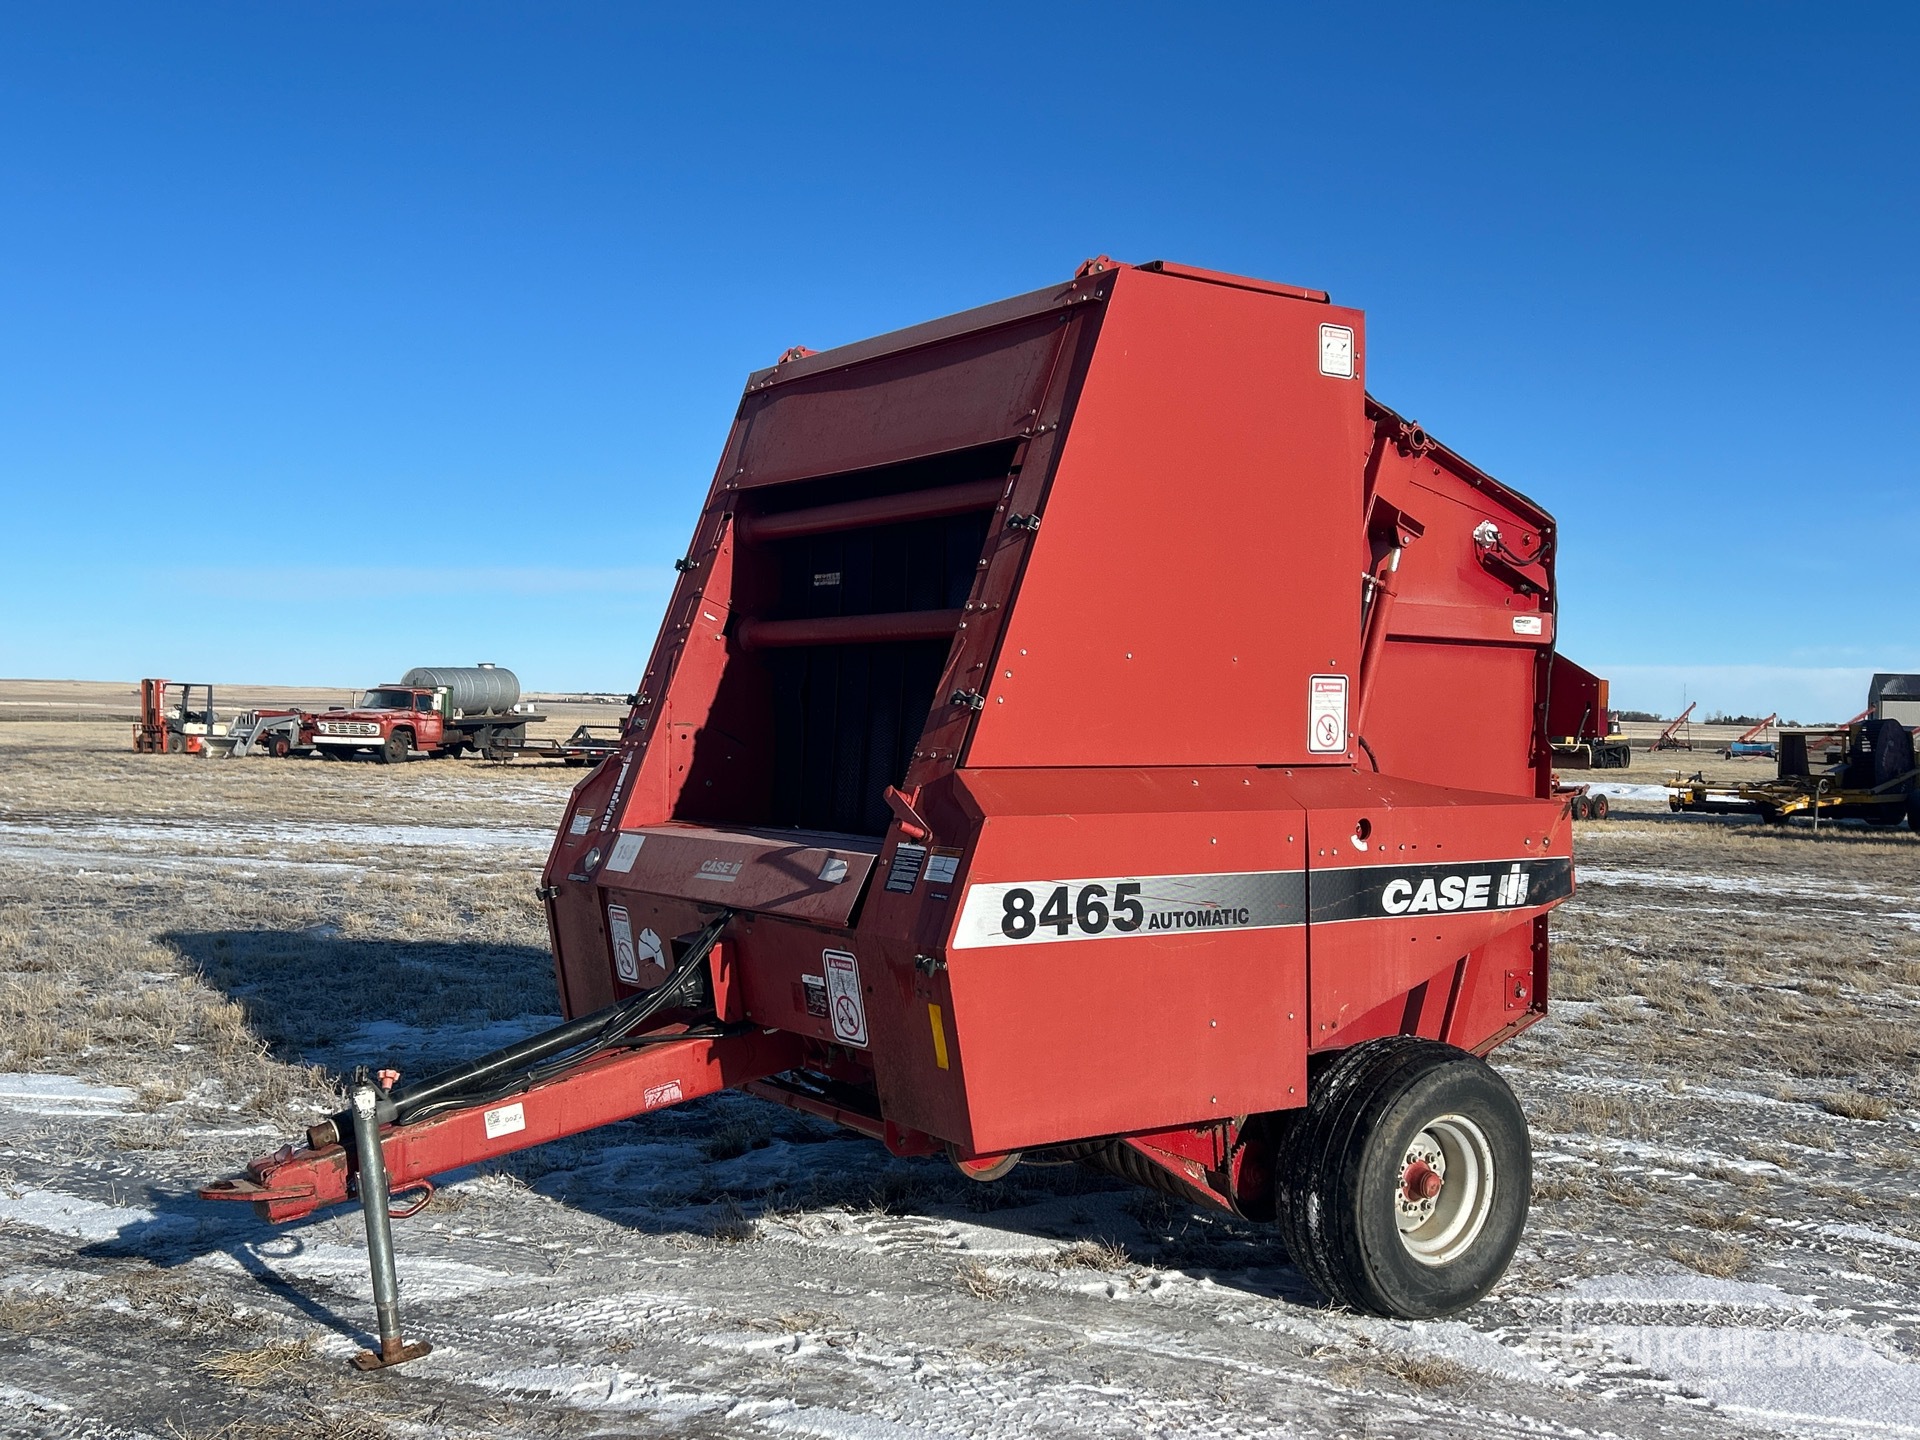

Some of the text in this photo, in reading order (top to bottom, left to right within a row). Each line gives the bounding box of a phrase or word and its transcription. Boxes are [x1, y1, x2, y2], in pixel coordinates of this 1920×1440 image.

[701, 859, 731, 874] CASE
[1001, 882, 1250, 940] 8465 AUTOMATIC
[1381, 874, 1491, 915] CASE
